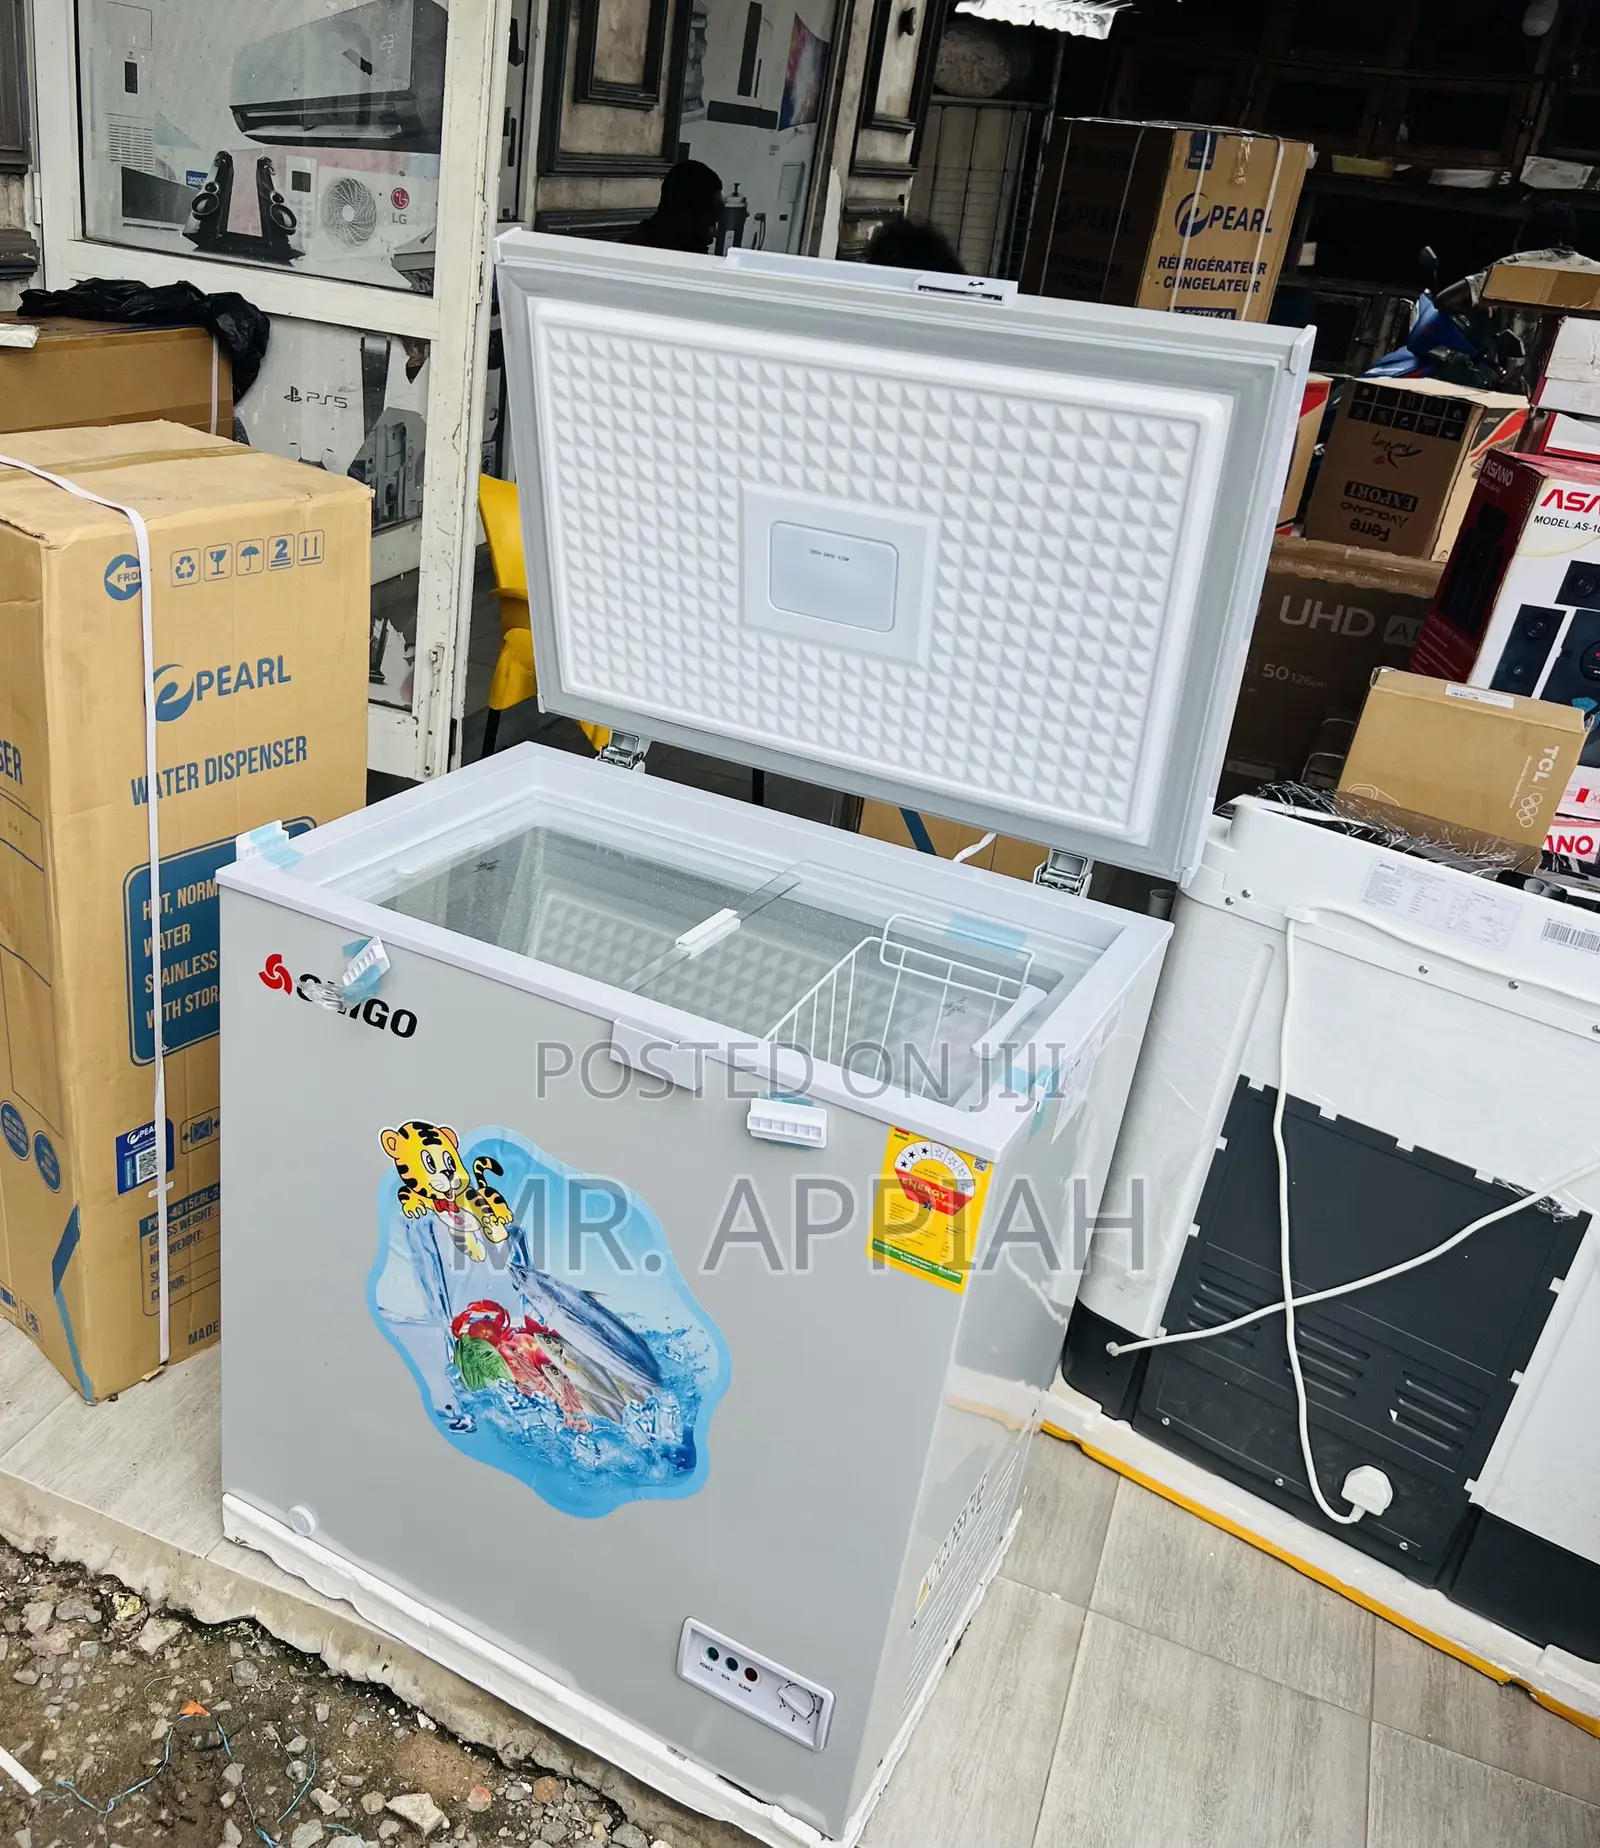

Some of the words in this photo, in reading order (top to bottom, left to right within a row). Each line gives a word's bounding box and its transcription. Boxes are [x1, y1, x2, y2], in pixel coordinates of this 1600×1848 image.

[391, 214, 408, 226] LG
[306, 391, 348, 409] PS5
[1348, 483, 1415, 511] EXPORT
[1350, 518, 1391, 543] Ferre
[1279, 595, 1376, 637] UHD
[196, 655, 292, 702] PEARL
[1262, 663, 1290, 681] 50
[204, 735, 308, 786] DISPENSER
[1532, 745, 1560, 783] TCL
[144, 950, 218, 994] SAINLESS
[146, 998, 182, 1030] WTH
[901, 1177, 948, 1202] ENERGY
[179, 1205, 215, 1232] WEIGHT:
[188, 1320, 219, 1346] MADE
